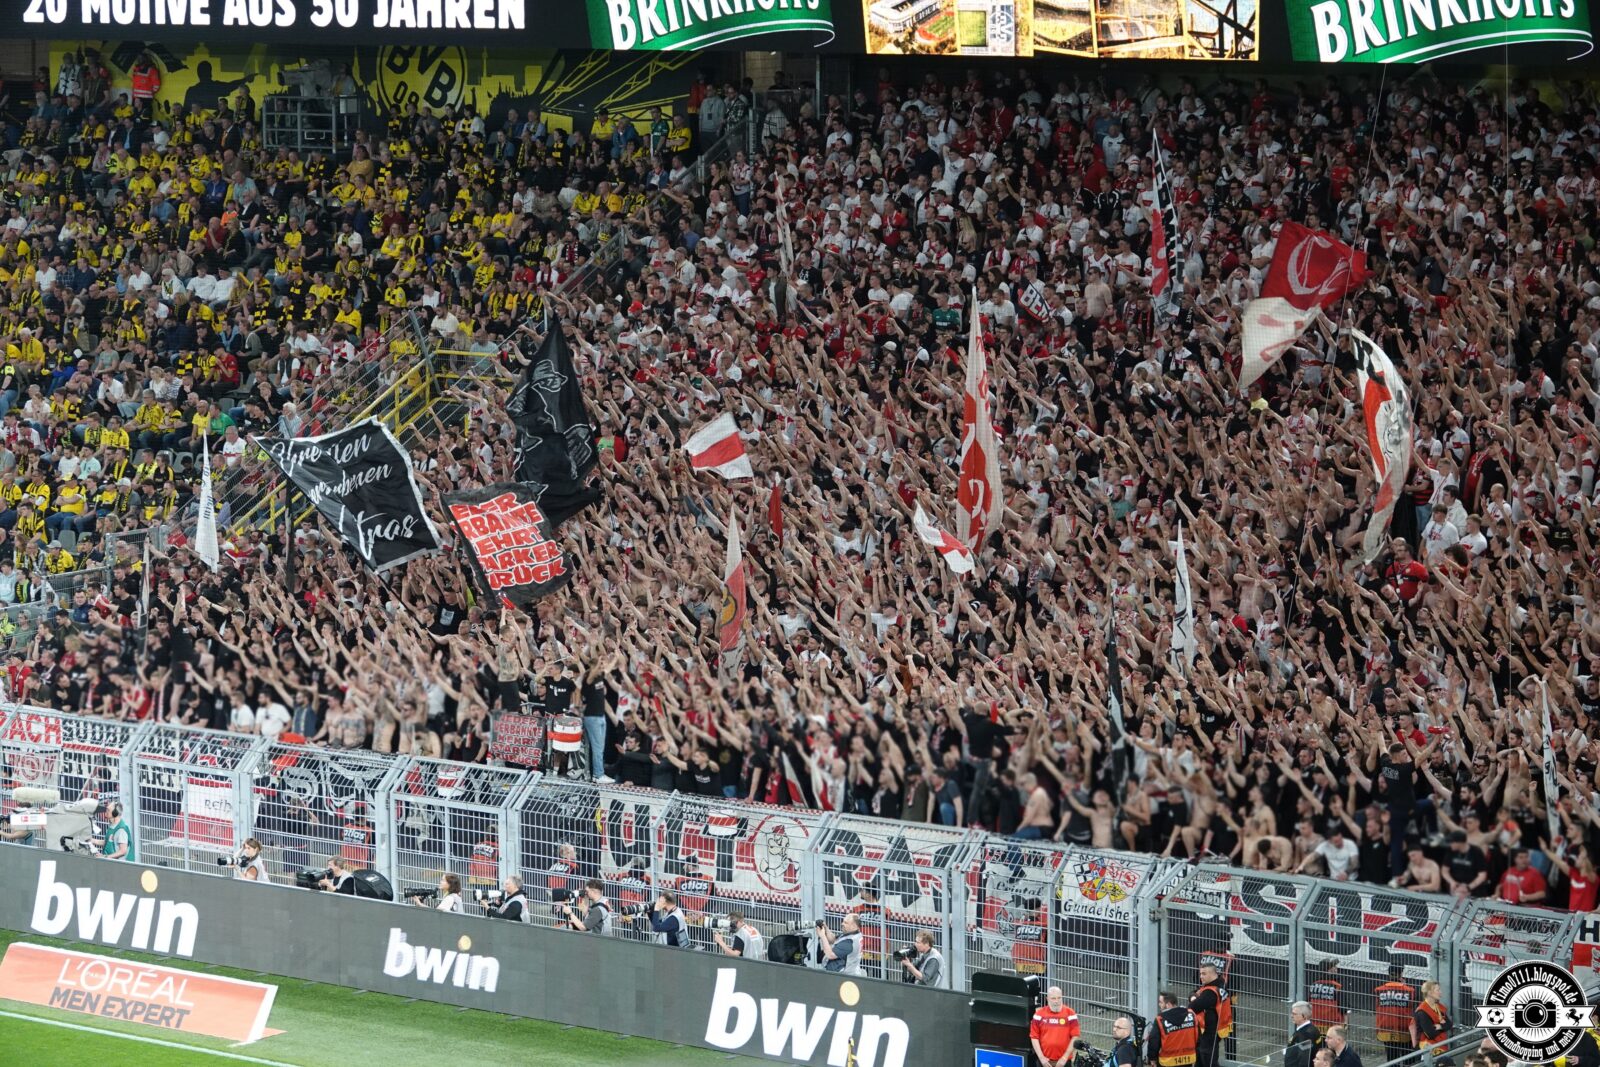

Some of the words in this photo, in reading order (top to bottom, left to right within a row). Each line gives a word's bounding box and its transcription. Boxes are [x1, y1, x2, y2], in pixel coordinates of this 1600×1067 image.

[23, 0, 67, 23] 20
[222, 0, 296, 27] AUS
[310, 0, 358, 27] 50
[373, 0, 525, 29] JAHREN
[681, 880, 708, 890] atlas
[31, 860, 199, 957] bwin
[57, 958, 194, 1007] L'ORÉAL
[383, 928, 500, 993] bwin
[48, 986, 101, 1013] MEN
[101, 996, 190, 1028] EXPERT
[704, 968, 910, 1067] bwin
[1380, 991, 1409, 1001] atlas
